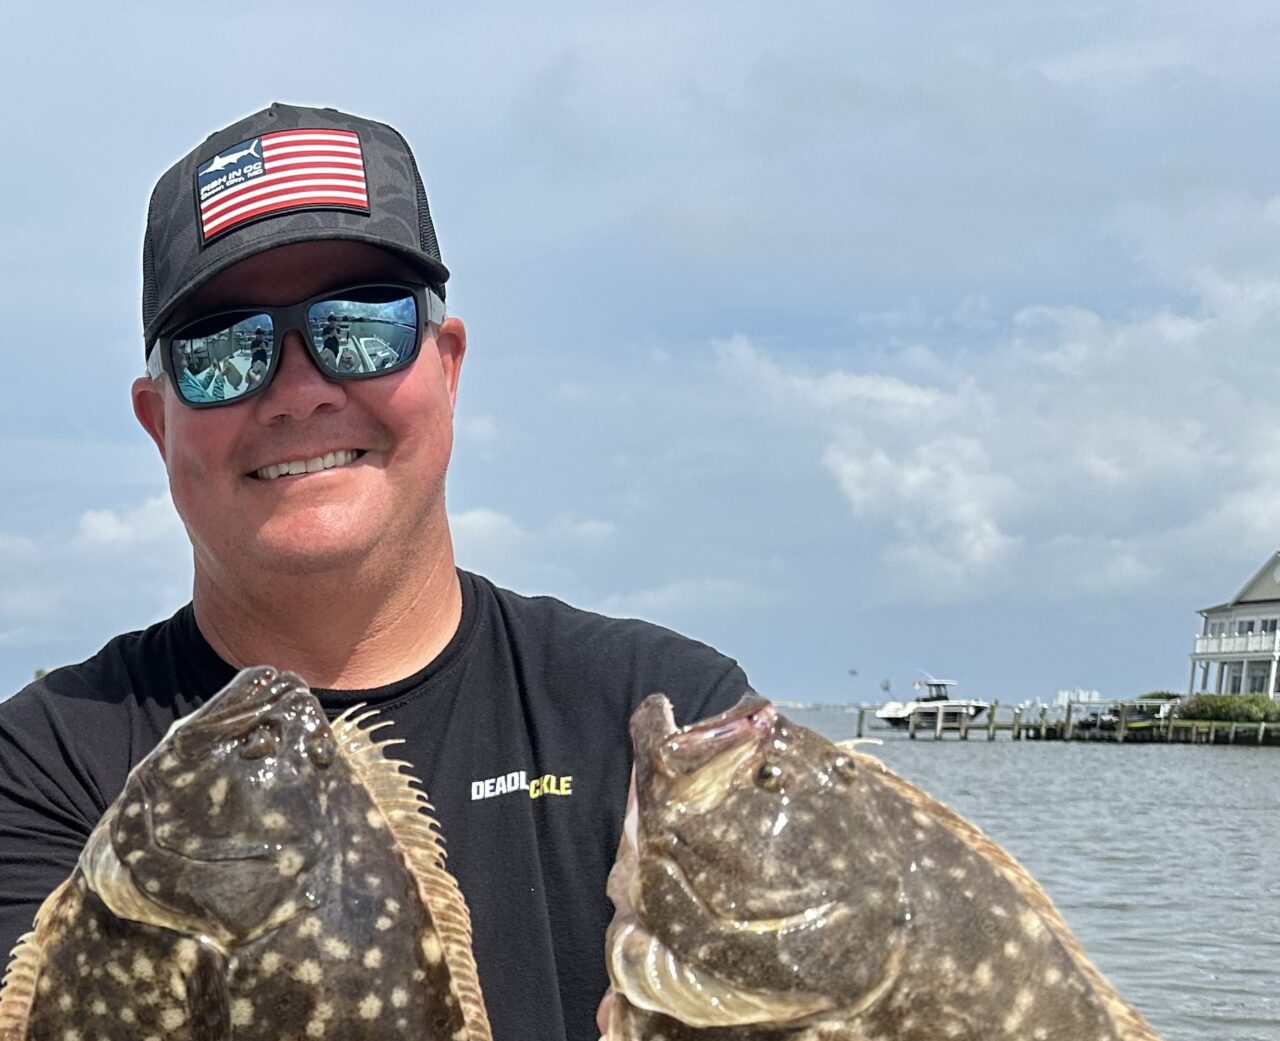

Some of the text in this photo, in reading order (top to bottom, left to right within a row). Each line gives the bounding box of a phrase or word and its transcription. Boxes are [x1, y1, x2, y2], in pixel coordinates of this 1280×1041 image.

[201, 162, 262, 195] FISH IN OC
[247, 169, 263, 178] MD
